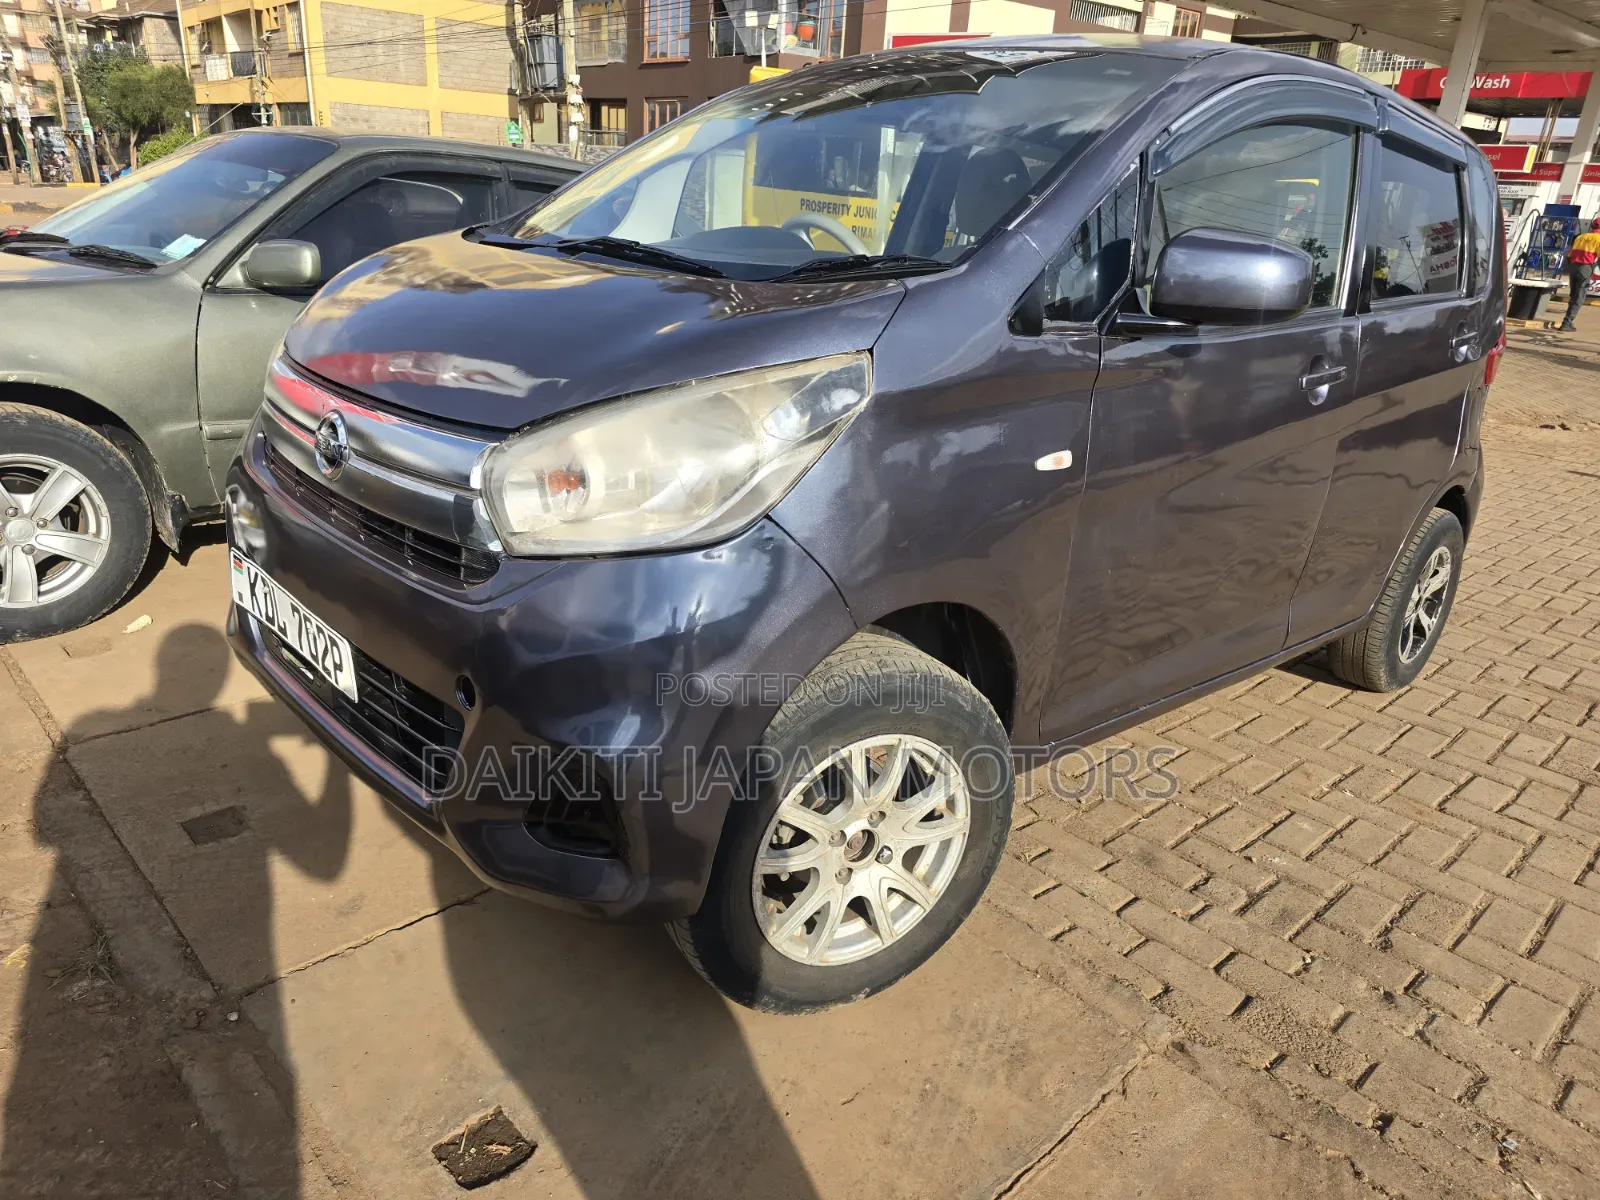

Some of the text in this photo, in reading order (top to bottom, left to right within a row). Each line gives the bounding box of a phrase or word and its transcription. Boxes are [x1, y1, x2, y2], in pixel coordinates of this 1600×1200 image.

[1539, 168, 1562, 177] Super
[800, 198, 852, 216] PROSPERITY
[851, 225, 876, 239] RIMA
[246, 565, 289, 640] KDL
